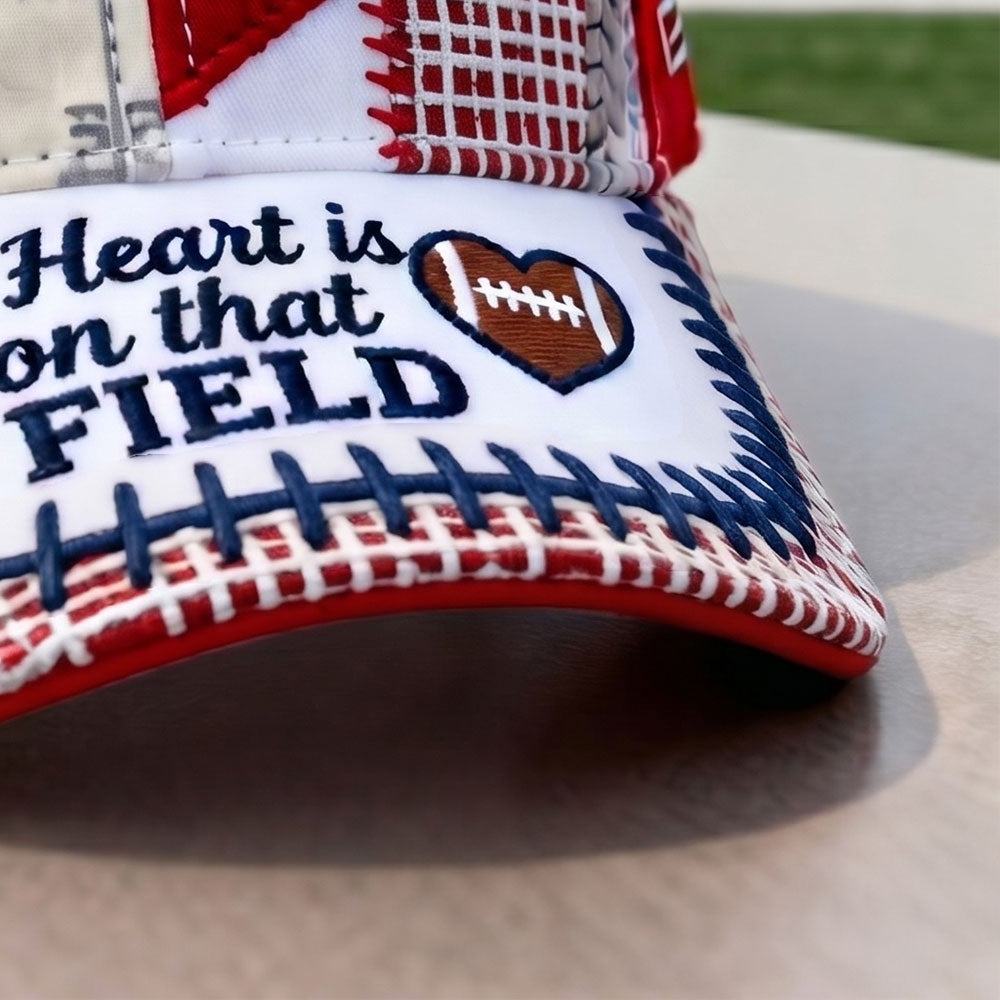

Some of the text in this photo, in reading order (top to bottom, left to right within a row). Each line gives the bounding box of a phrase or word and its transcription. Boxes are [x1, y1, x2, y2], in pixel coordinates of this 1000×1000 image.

[0, 205, 305, 310] Heart
[325, 201, 409, 265] is
[151, 272, 385, 355] that
[3, 346, 470, 484] FIELD
